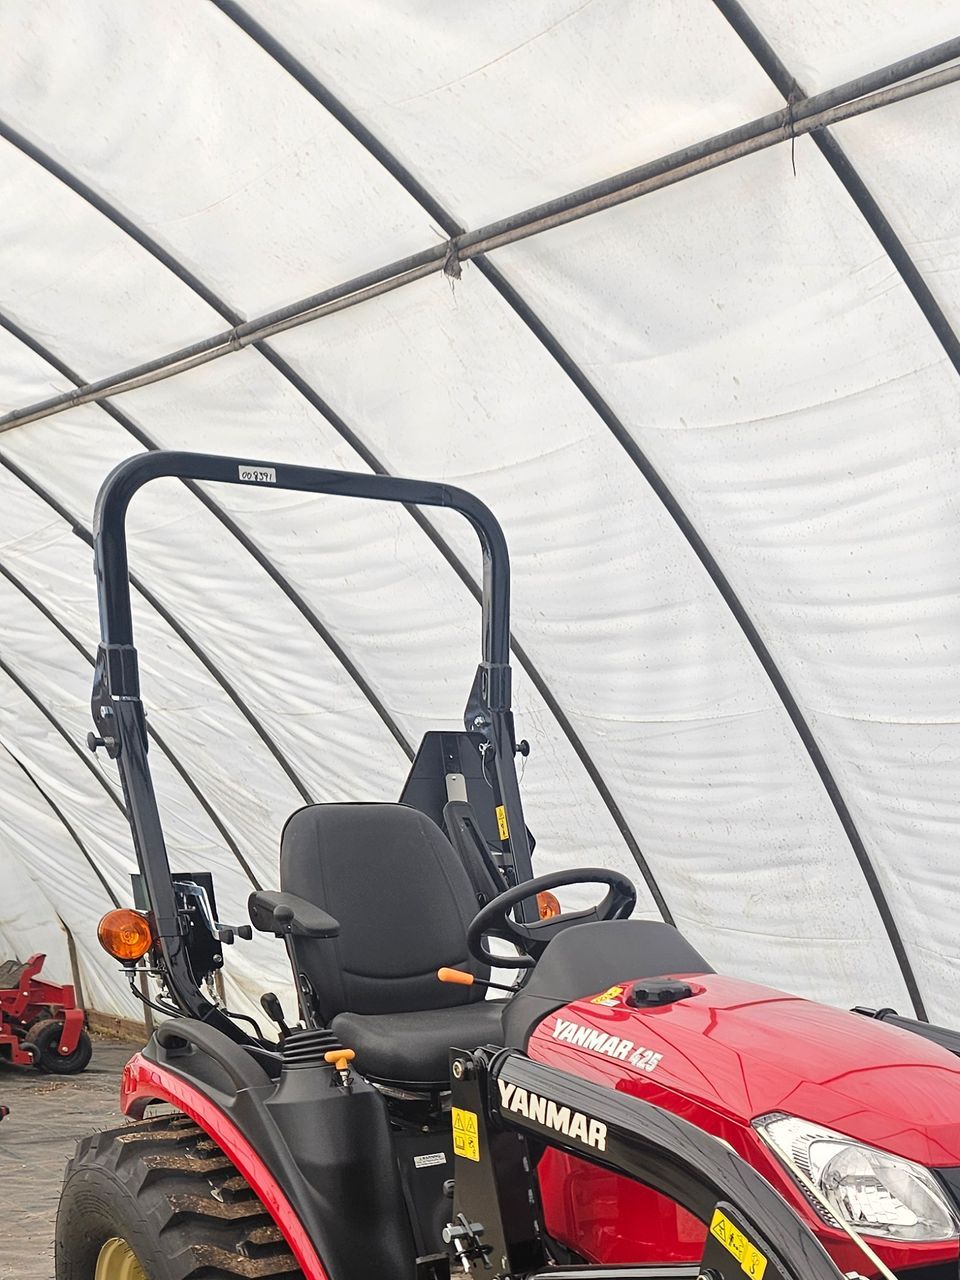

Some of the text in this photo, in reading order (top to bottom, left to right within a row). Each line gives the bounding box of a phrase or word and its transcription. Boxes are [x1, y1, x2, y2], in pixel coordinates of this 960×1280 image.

[551, 1018, 664, 1073] YANMAR 425
[497, 1078, 608, 1152] YANMAR
